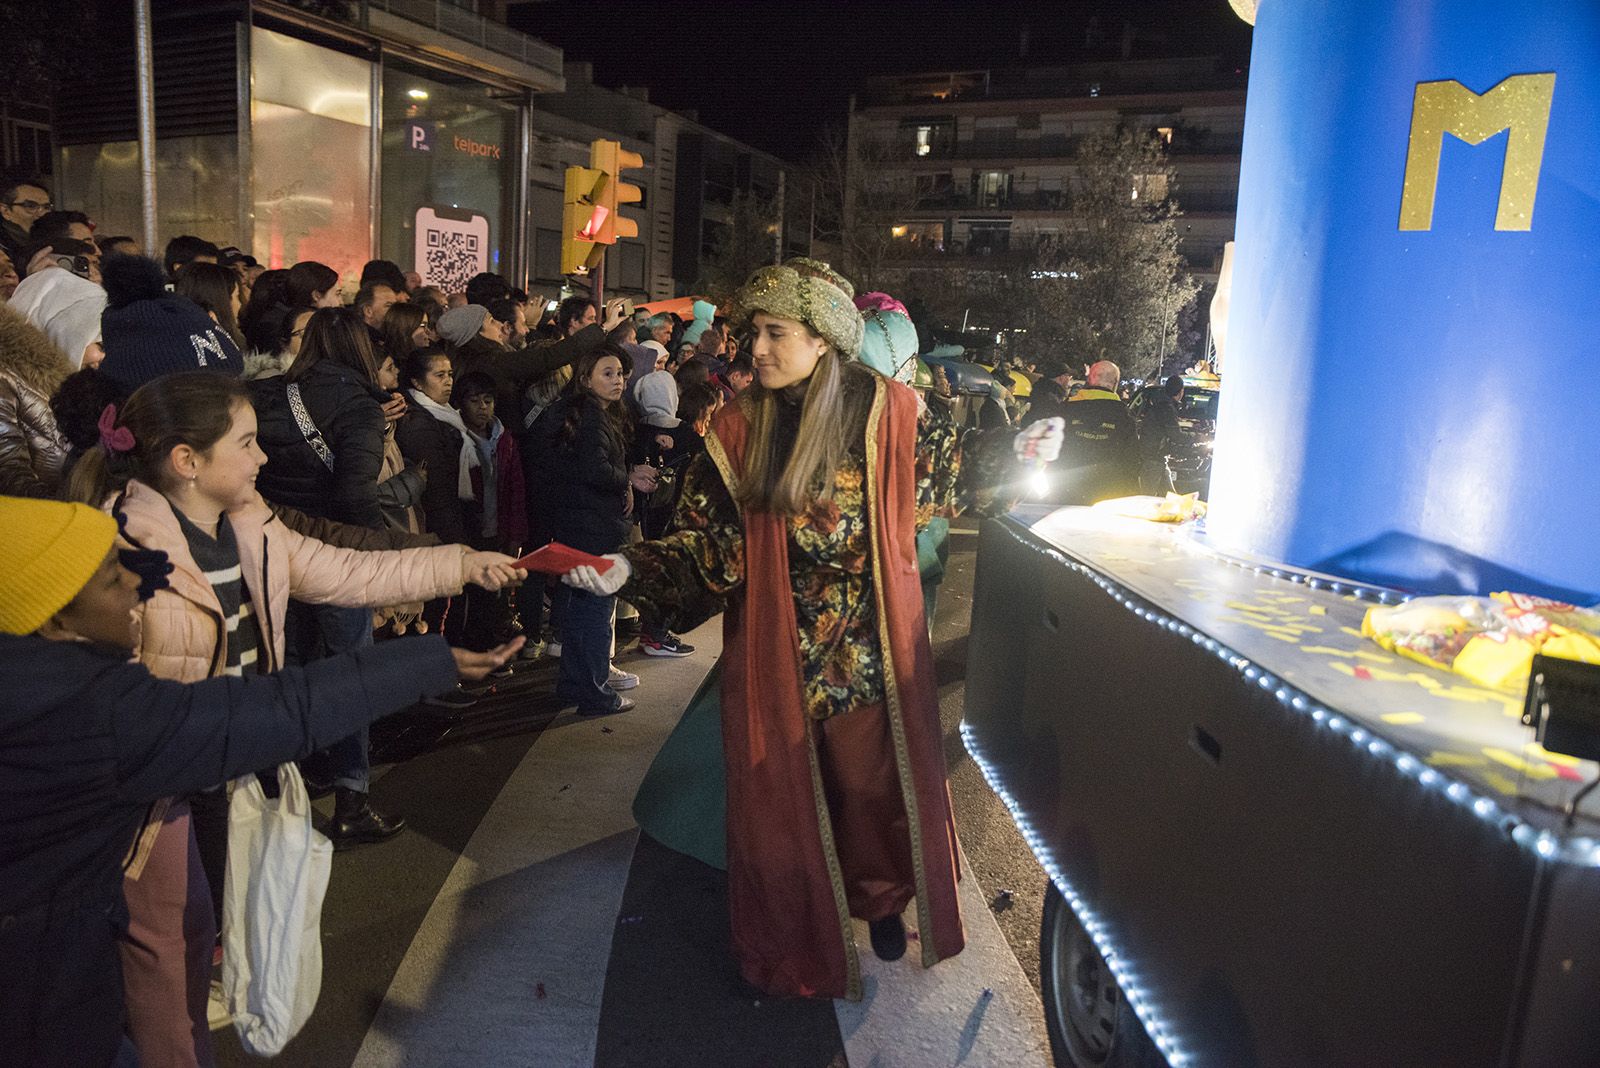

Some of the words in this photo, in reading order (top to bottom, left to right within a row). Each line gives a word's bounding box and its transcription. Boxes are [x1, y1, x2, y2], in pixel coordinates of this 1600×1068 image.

[412, 126, 425, 149] P
[454, 136, 500, 159] telpark
[1398, 73, 1556, 231] M
